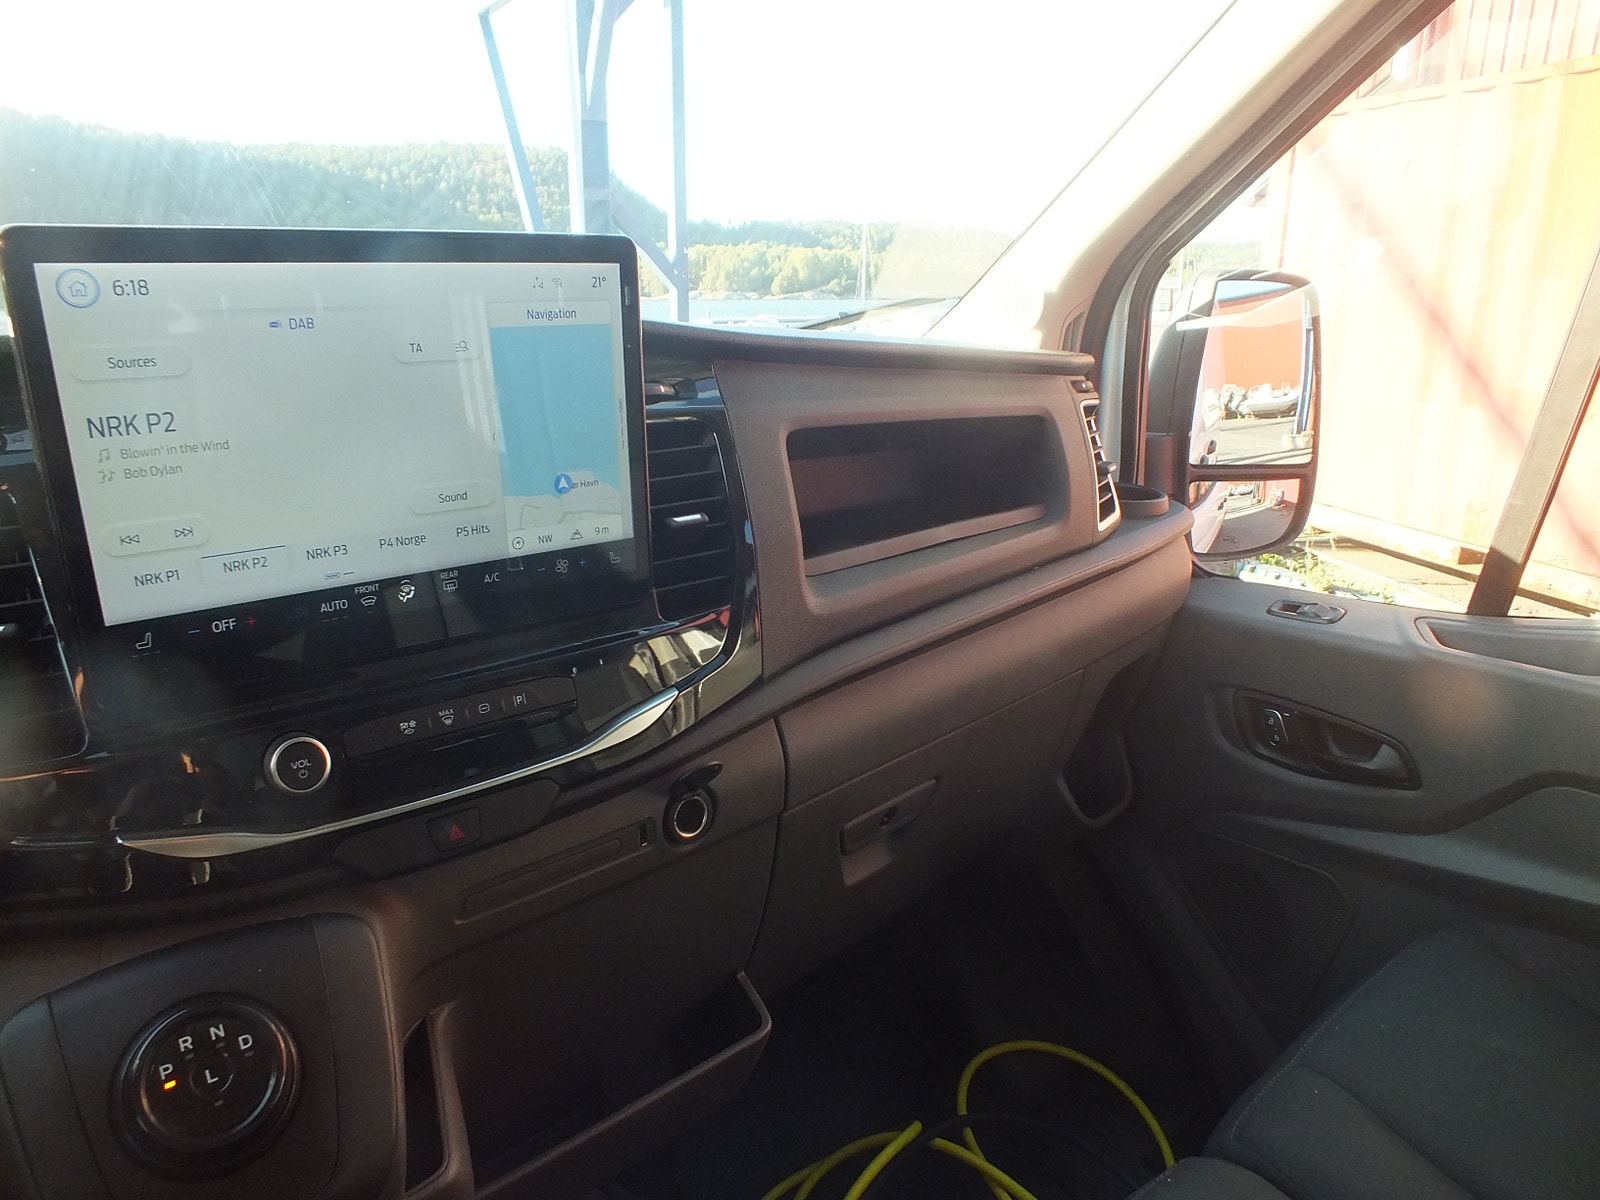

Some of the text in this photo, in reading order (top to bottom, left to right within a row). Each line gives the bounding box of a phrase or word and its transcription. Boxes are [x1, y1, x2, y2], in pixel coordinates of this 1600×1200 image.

[112, 279, 149, 297] 6:18
[591, 276, 607, 289] 21°
[526, 308, 577, 321] Navigation
[288, 317, 315, 330] DAB
[409, 342, 423, 354] TA
[107, 355, 157, 370] Sources
[86, 411, 177, 439] NRK P2
[120, 440, 230, 460] Blowin' in the Wind
[123, 464, 183, 480] Bob Dylan
[438, 490, 468, 504] Sound
[456, 524, 491, 538] P5 Hits
[594, 526, 610, 536] 9 m
[379, 533, 427, 550] P4 Norge
[537, 534, 553, 546] NW
[307, 544, 349, 561] NRK P3
[223, 556, 268, 574] NRK P2
[134, 569, 181, 588] NRK P1
[440, 569, 459, 580] REAR
[484, 572, 501, 584] A/C
[354, 583, 380, 595] FRONT
[320, 599, 349, 614] AUTO
[211, 618, 237, 634] OFF
[438, 708, 455, 717] MAX
[290, 758, 312, 770] VOL
[209, 1023, 226, 1041] N
[178, 1035, 194, 1052] R
[237, 1034, 253, 1050] D
[158, 1063, 174, 1080] P
[205, 1069, 219, 1084] L
